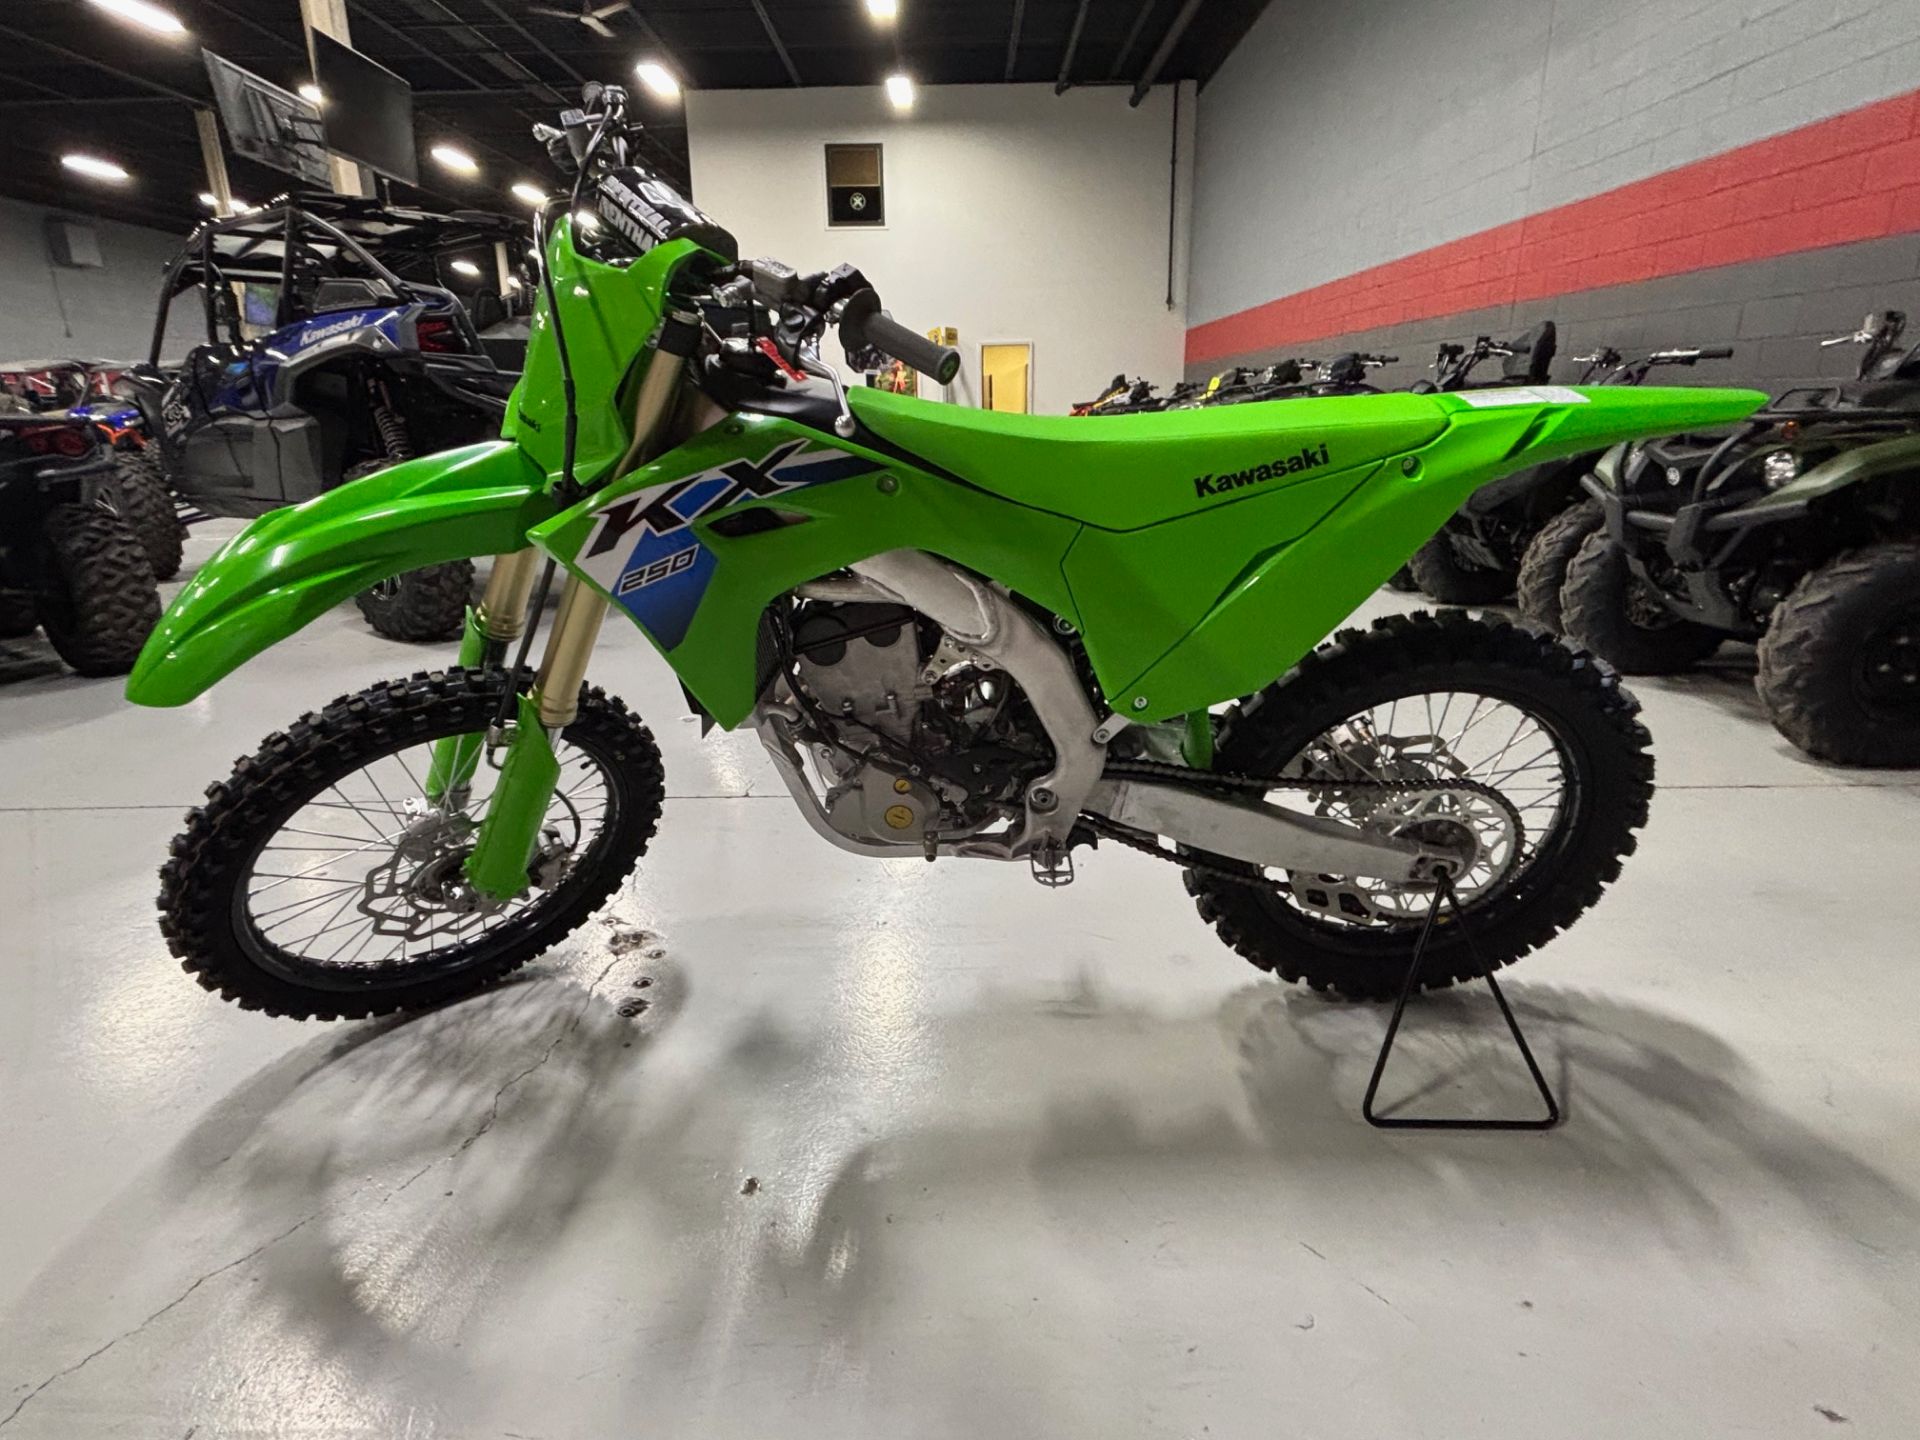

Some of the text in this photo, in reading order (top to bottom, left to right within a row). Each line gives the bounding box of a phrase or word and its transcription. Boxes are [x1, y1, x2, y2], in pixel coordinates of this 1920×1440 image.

[599, 193, 658, 254] RENTHA
[299, 313, 366, 346] Kawasaki
[1193, 443, 1330, 498] Kawasaki
[584, 438, 811, 559] KX
[618, 544, 699, 595] 250
